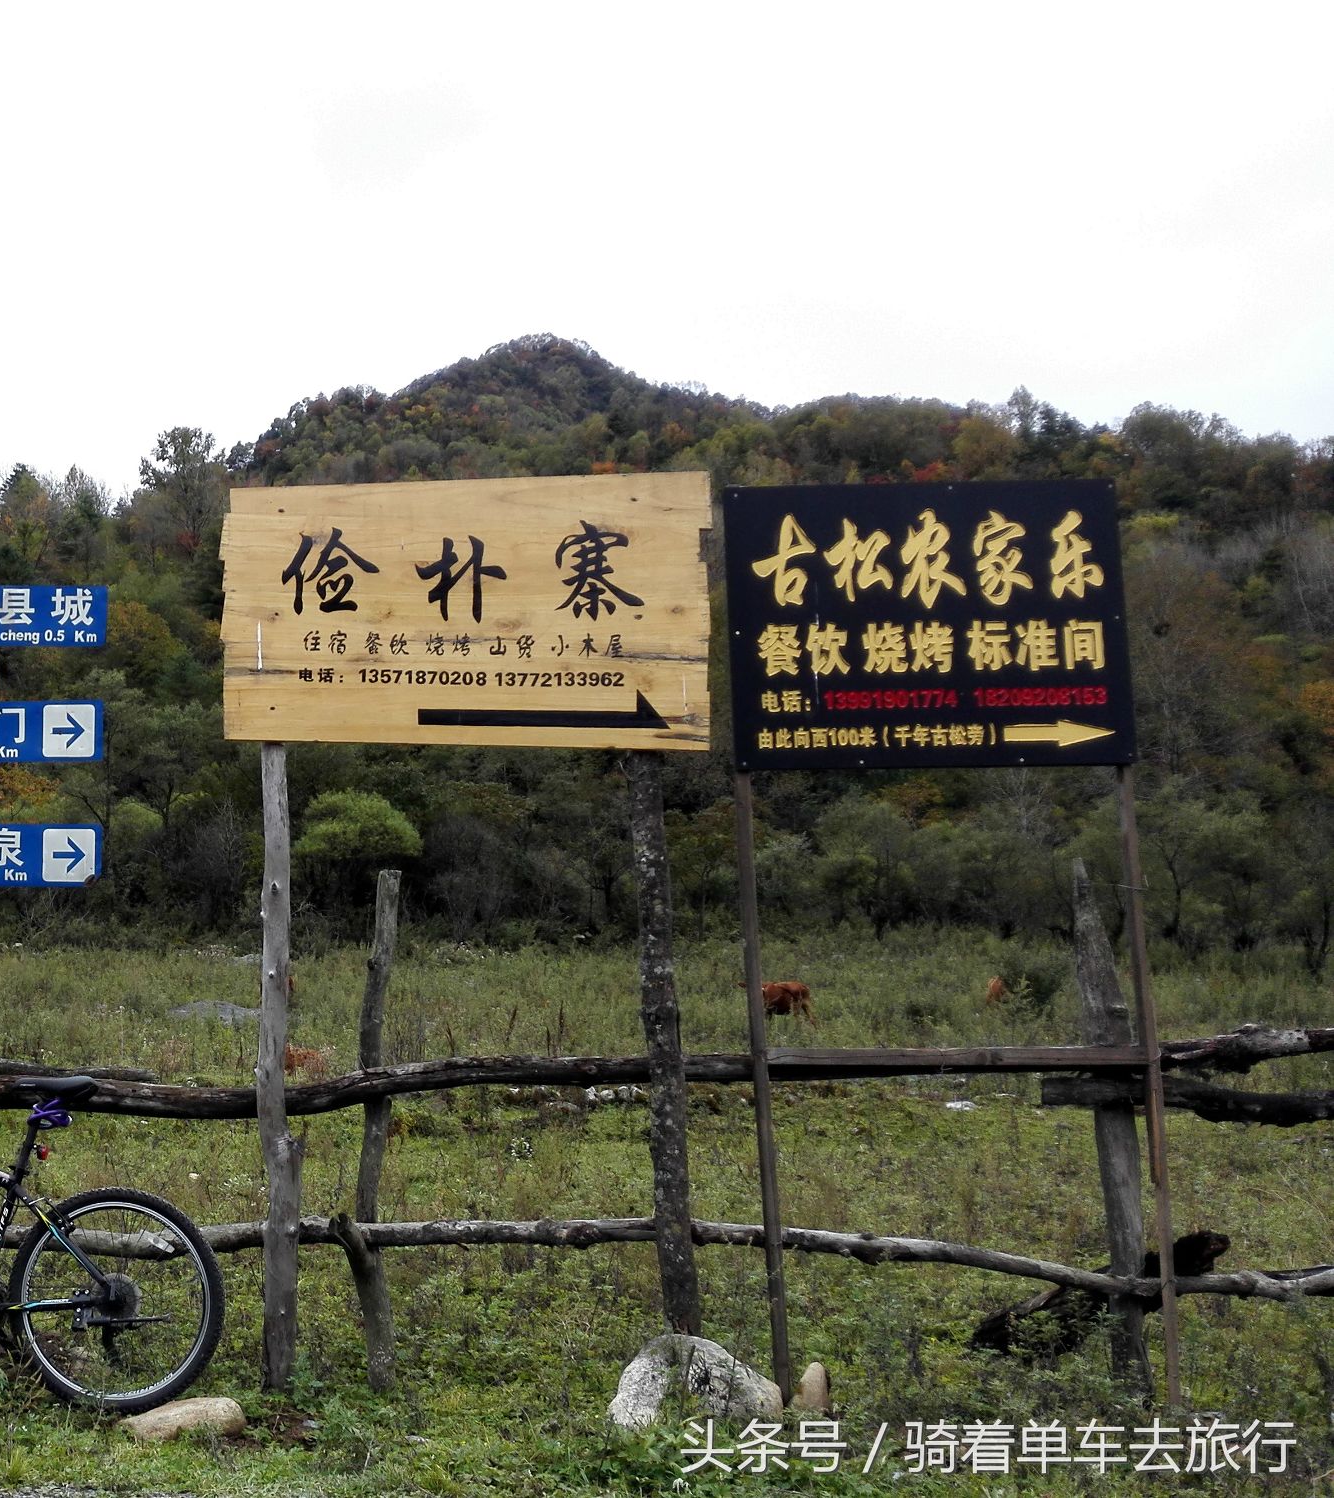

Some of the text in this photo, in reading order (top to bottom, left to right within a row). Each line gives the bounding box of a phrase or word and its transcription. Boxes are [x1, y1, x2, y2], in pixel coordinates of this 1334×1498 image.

[280, 519, 645, 624] 俭朴寨
[751, 507, 1105, 610] 古松农家乐
[0, 629, 40, 645] cheng
[44, 629, 65, 642] 0.5
[74, 630, 97, 643] Km
[303, 630, 624, 659] 住宿 餐饮 烧烤 山货 小木屋
[756, 618, 1106, 680] 餐饮 烧烤 标准间
[358, 668, 487, 687] 13571870208
[494, 671, 625, 688] 13772133962
[4, 868, 27, 881] Km
